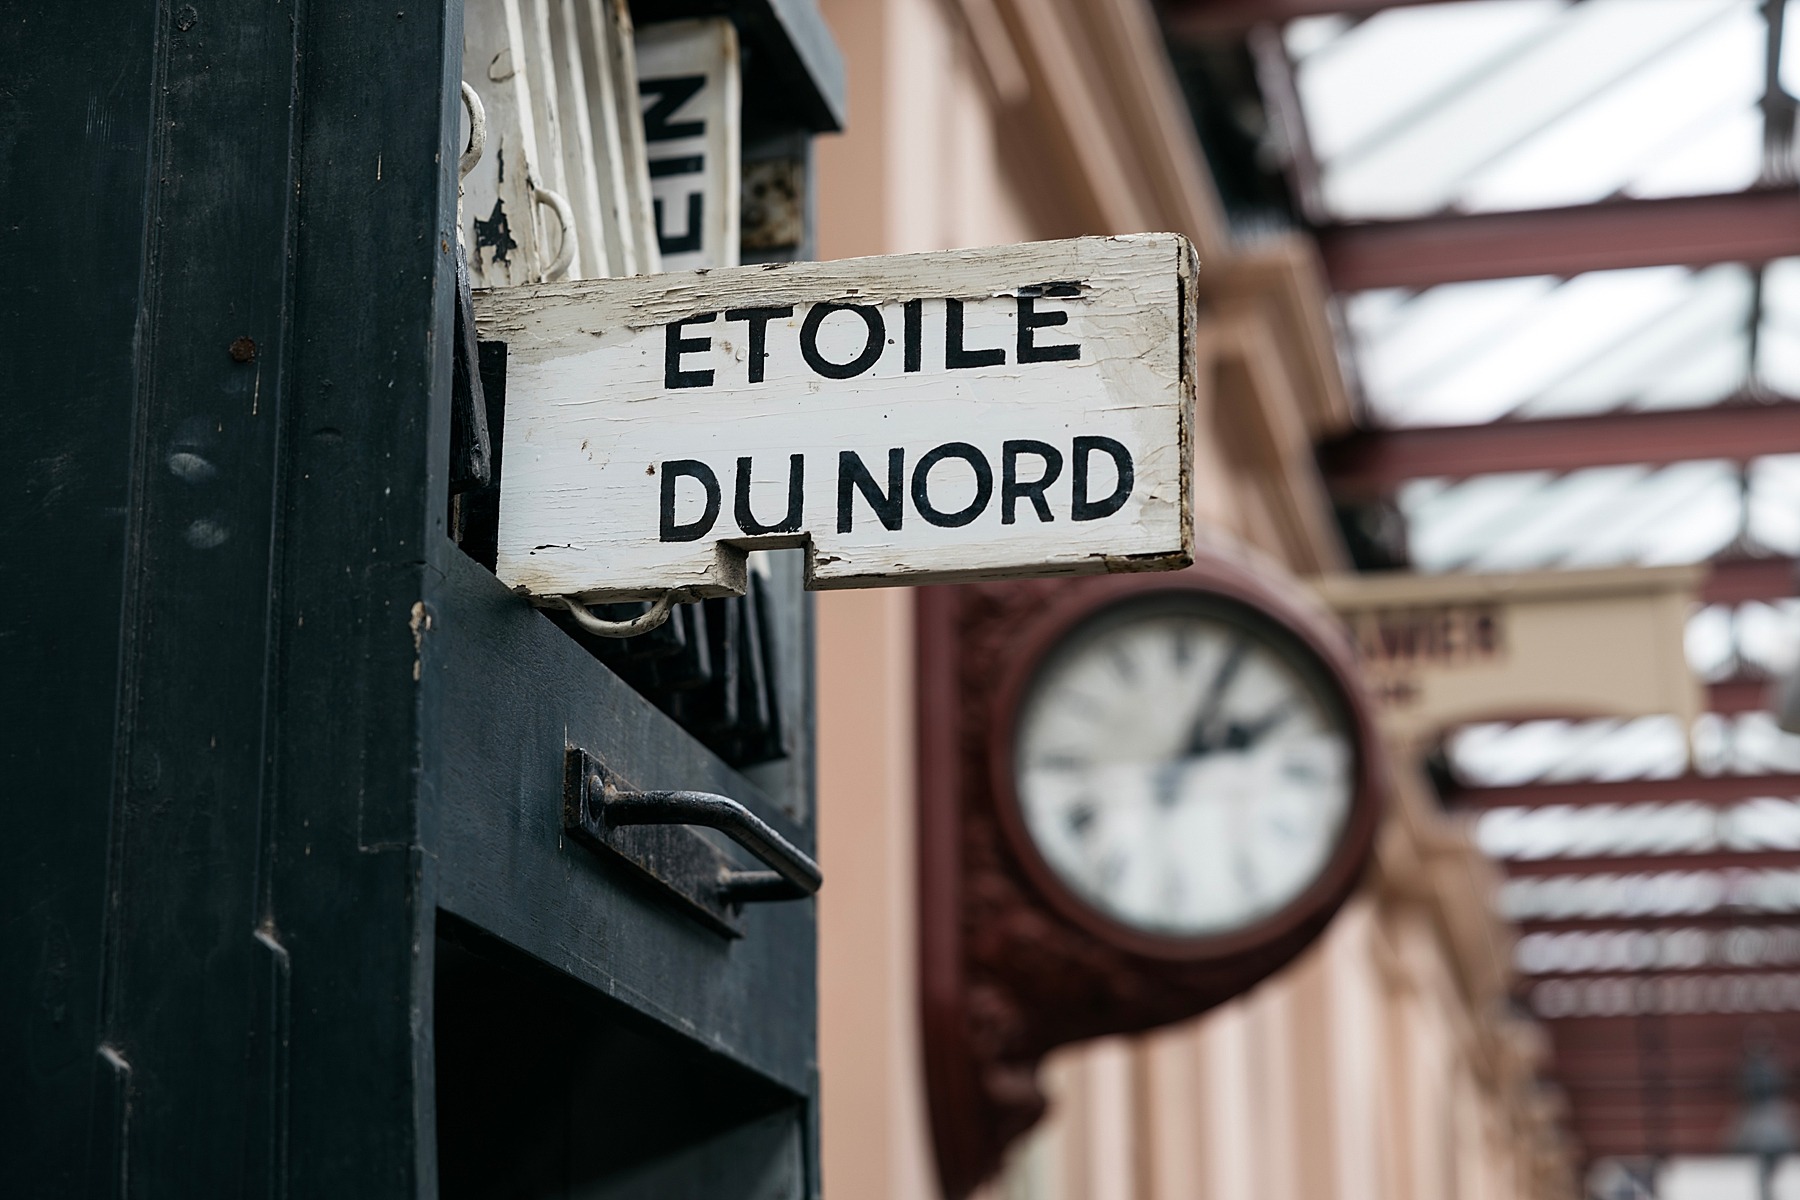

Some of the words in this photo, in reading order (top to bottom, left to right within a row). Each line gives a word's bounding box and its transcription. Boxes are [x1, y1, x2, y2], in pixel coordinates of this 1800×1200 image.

[664, 282, 1082, 389] ETOILE
[660, 453, 804, 542] DU
[837, 436, 1134, 534] NORD
